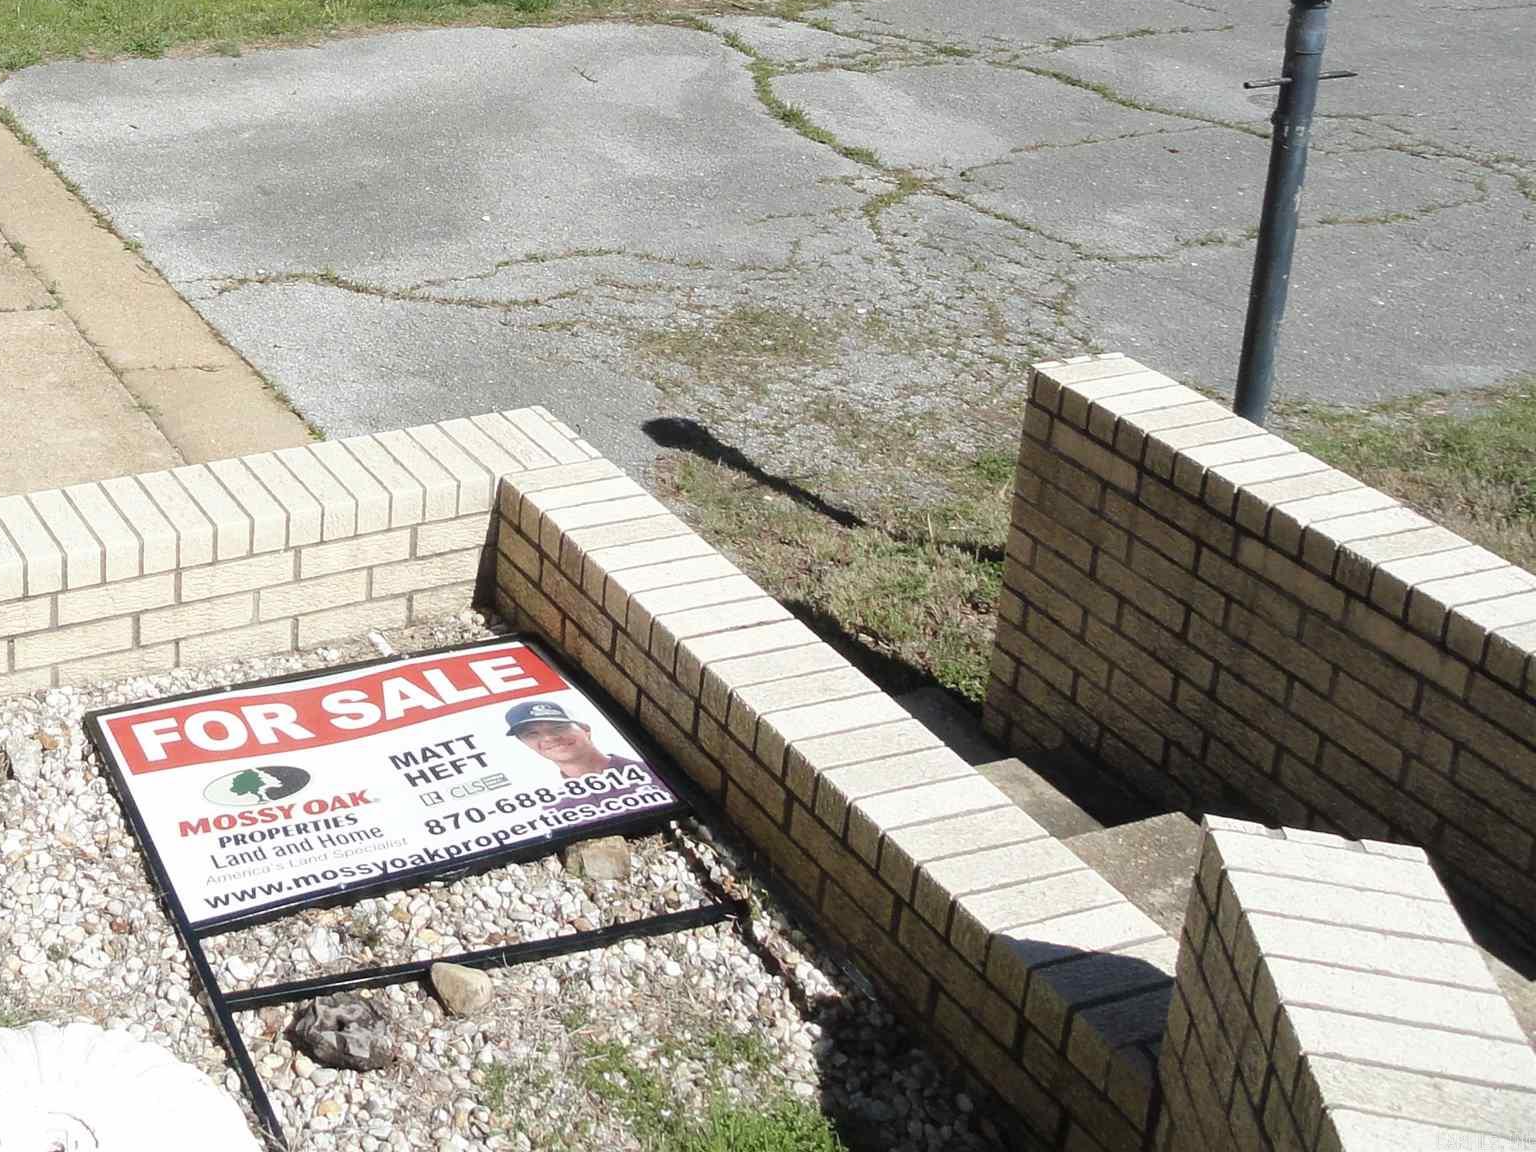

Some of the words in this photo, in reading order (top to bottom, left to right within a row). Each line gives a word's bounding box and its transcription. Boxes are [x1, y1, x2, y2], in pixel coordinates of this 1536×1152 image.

[131, 703, 316, 762] FOR
[321, 656, 539, 730] SALE
[388, 734, 477, 770] MATT
[404, 752, 488, 787] HEFT
[177, 803, 296, 837] MOSSY
[303, 788, 372, 816] OAK
[424, 766, 646, 836] 870-688-8614
[203, 786, 670, 909] www.mossyoakproperties.com
[210, 842, 268, 869] Land
[275, 833, 315, 858] and
[316, 824, 385, 849] Home
[217, 812, 359, 849] PROPERTIES
[205, 862, 286, 887] America's
[289, 851, 328, 868] Land
[332, 836, 409, 860] Specialist
